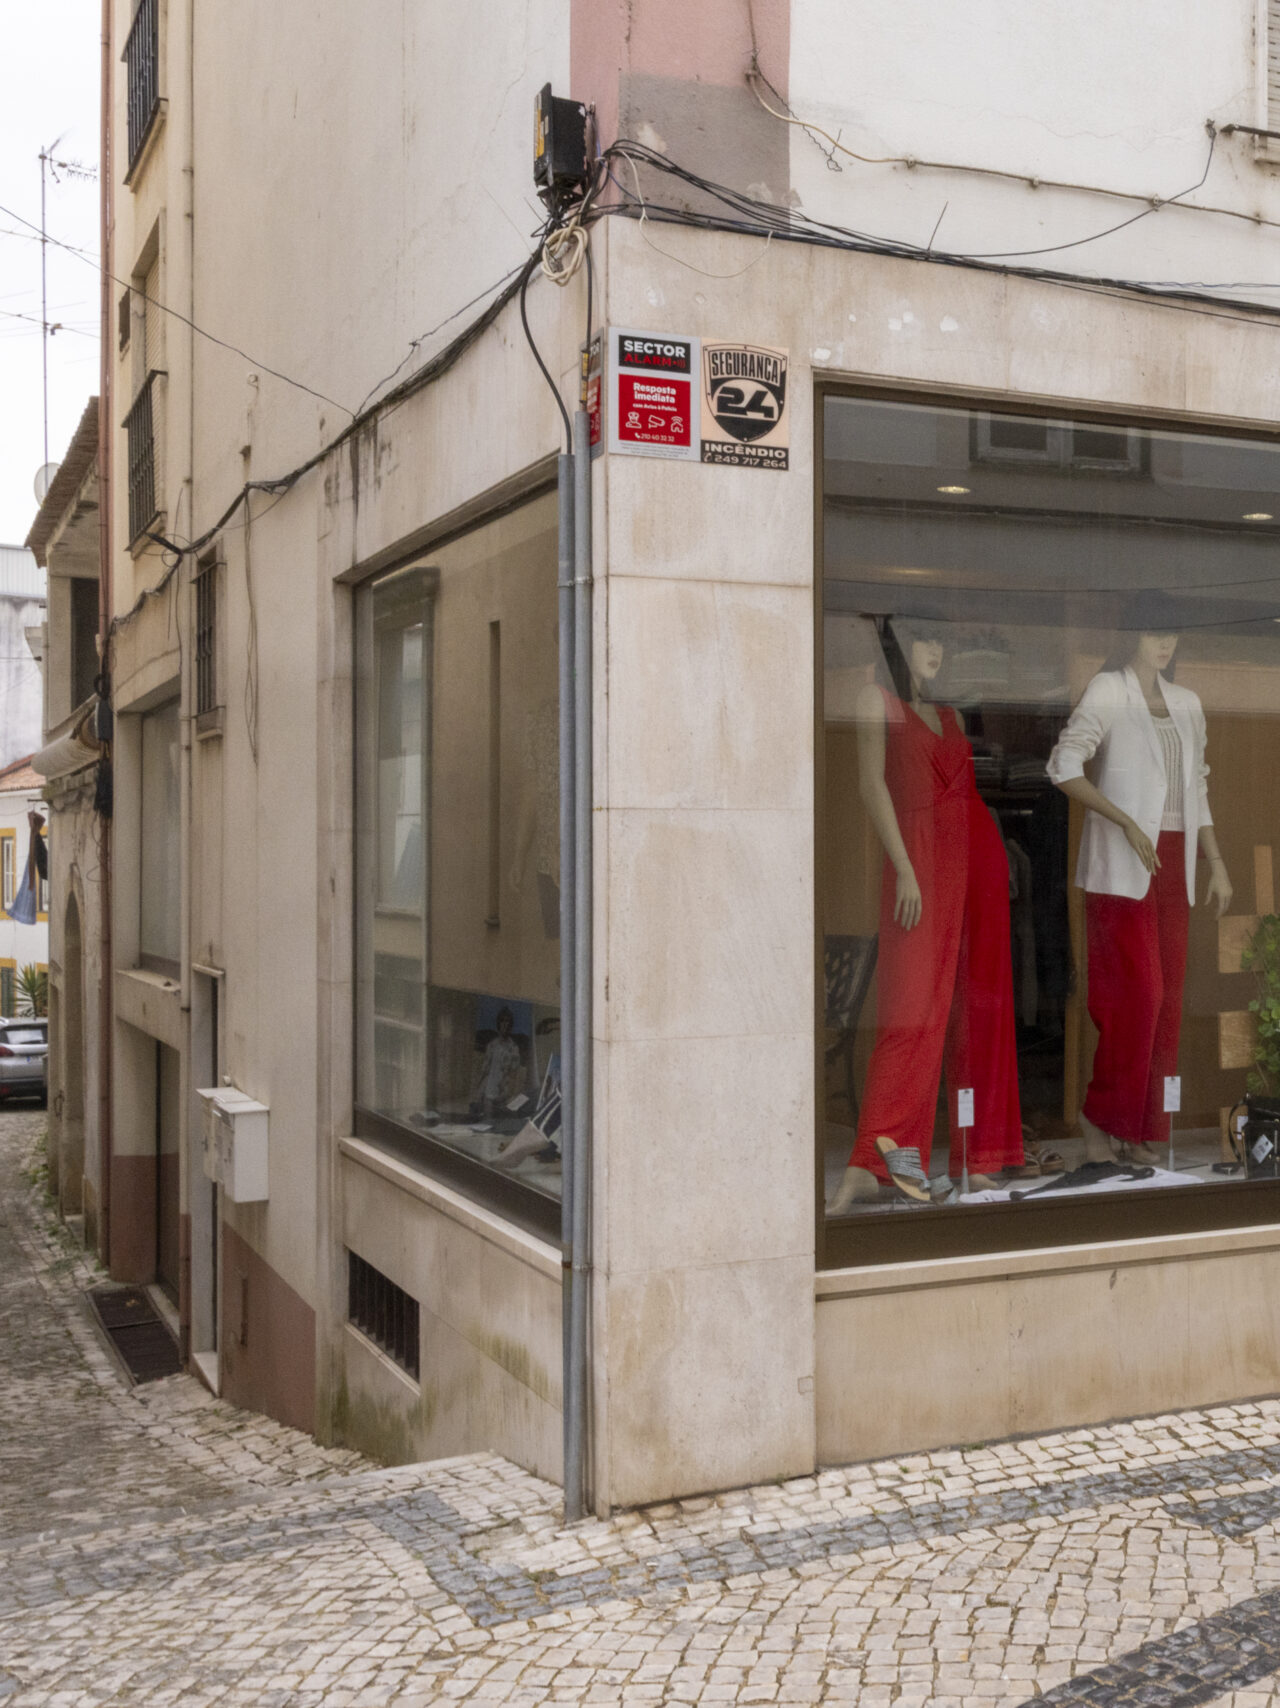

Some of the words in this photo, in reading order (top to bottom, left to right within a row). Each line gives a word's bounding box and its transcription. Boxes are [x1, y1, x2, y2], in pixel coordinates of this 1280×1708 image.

[624, 340, 686, 358] SECTOR
[624, 352, 672, 367] ALARM
[633, 382, 676, 395] Resposta
[717, 386, 774, 419] 24
[704, 442, 786, 459] INCÊNDIO
[714, 454, 739, 464] 249
[742, 457, 761, 466] 717
[762, 459, 786, 468] 264
